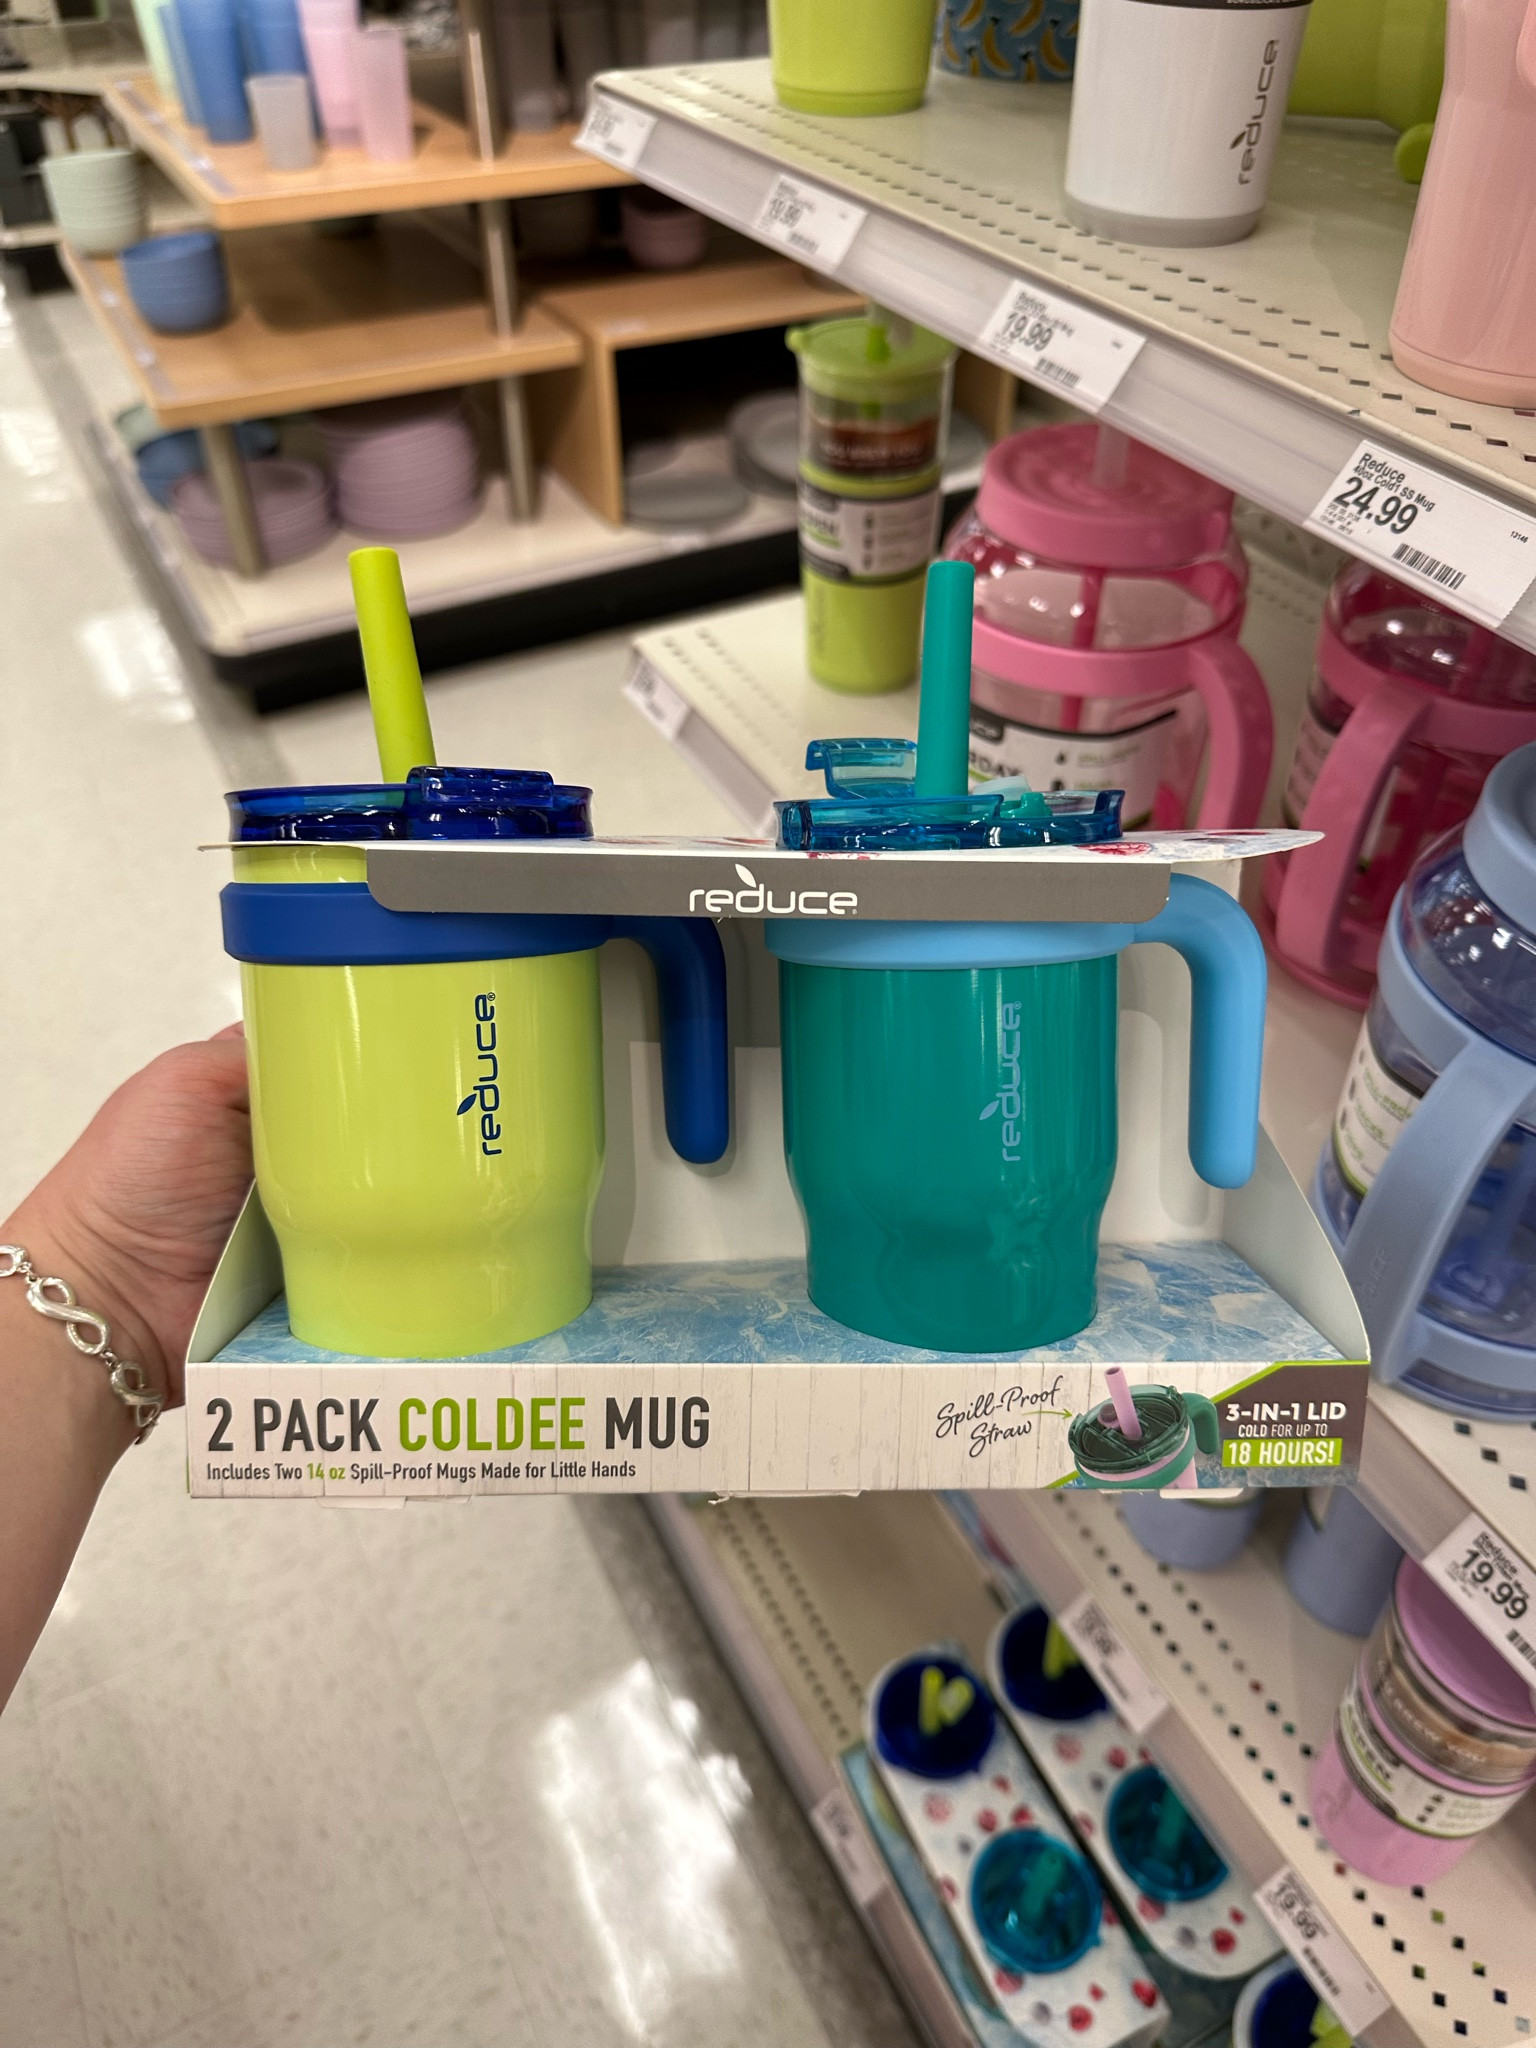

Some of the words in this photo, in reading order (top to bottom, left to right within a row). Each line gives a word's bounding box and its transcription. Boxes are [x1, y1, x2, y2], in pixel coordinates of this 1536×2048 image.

[1237, 38, 1280, 185] reduce
[1002, 312, 1053, 352] 19.99
[1358, 452, 1406, 483] Reduce
[1332, 476, 1418, 535] 24.99
[1352, 465, 1375, 482] 40oz
[1374, 475, 1401, 493] Cold1
[1400, 487, 1415, 500] SS
[1414, 493, 1436, 512] Mug
[206, 1397, 234, 1452] 2
[253, 1398, 382, 1452] PACK
[399, 1397, 586, 1452] COLDEE
[605, 1396, 710, 1450] MUG
[935, 1375, 1064, 1438] Spill-Proof
[1225, 1403, 1300, 1421] 3-IN-1
[1307, 1402, 1347, 1420] LID
[968, 1420, 1032, 1458] Straw
[1238, 1424, 1268, 1438] COLD
[1271, 1424, 1292, 1437] FOR
[1295, 1424, 1311, 1436] UP
[1315, 1423, 1328, 1436] TO
[207, 1463, 270, 1480] Includes
[274, 1463, 302, 1480] Two
[307, 1463, 325, 1480] 14
[329, 1466, 346, 1480] oz
[351, 1463, 432, 1484] Spill-Proof
[437, 1462, 476, 1483] Mugs
[481, 1461, 521, 1479] Made
[525, 1461, 547, 1478] for
[551, 1461, 587, 1478] Little
[591, 1460, 636, 1478] Hands
[1228, 1441, 1252, 1465] 18
[1259, 1440, 1335, 1465] HOURS!
[1462, 1548, 1528, 1619] 19.99
